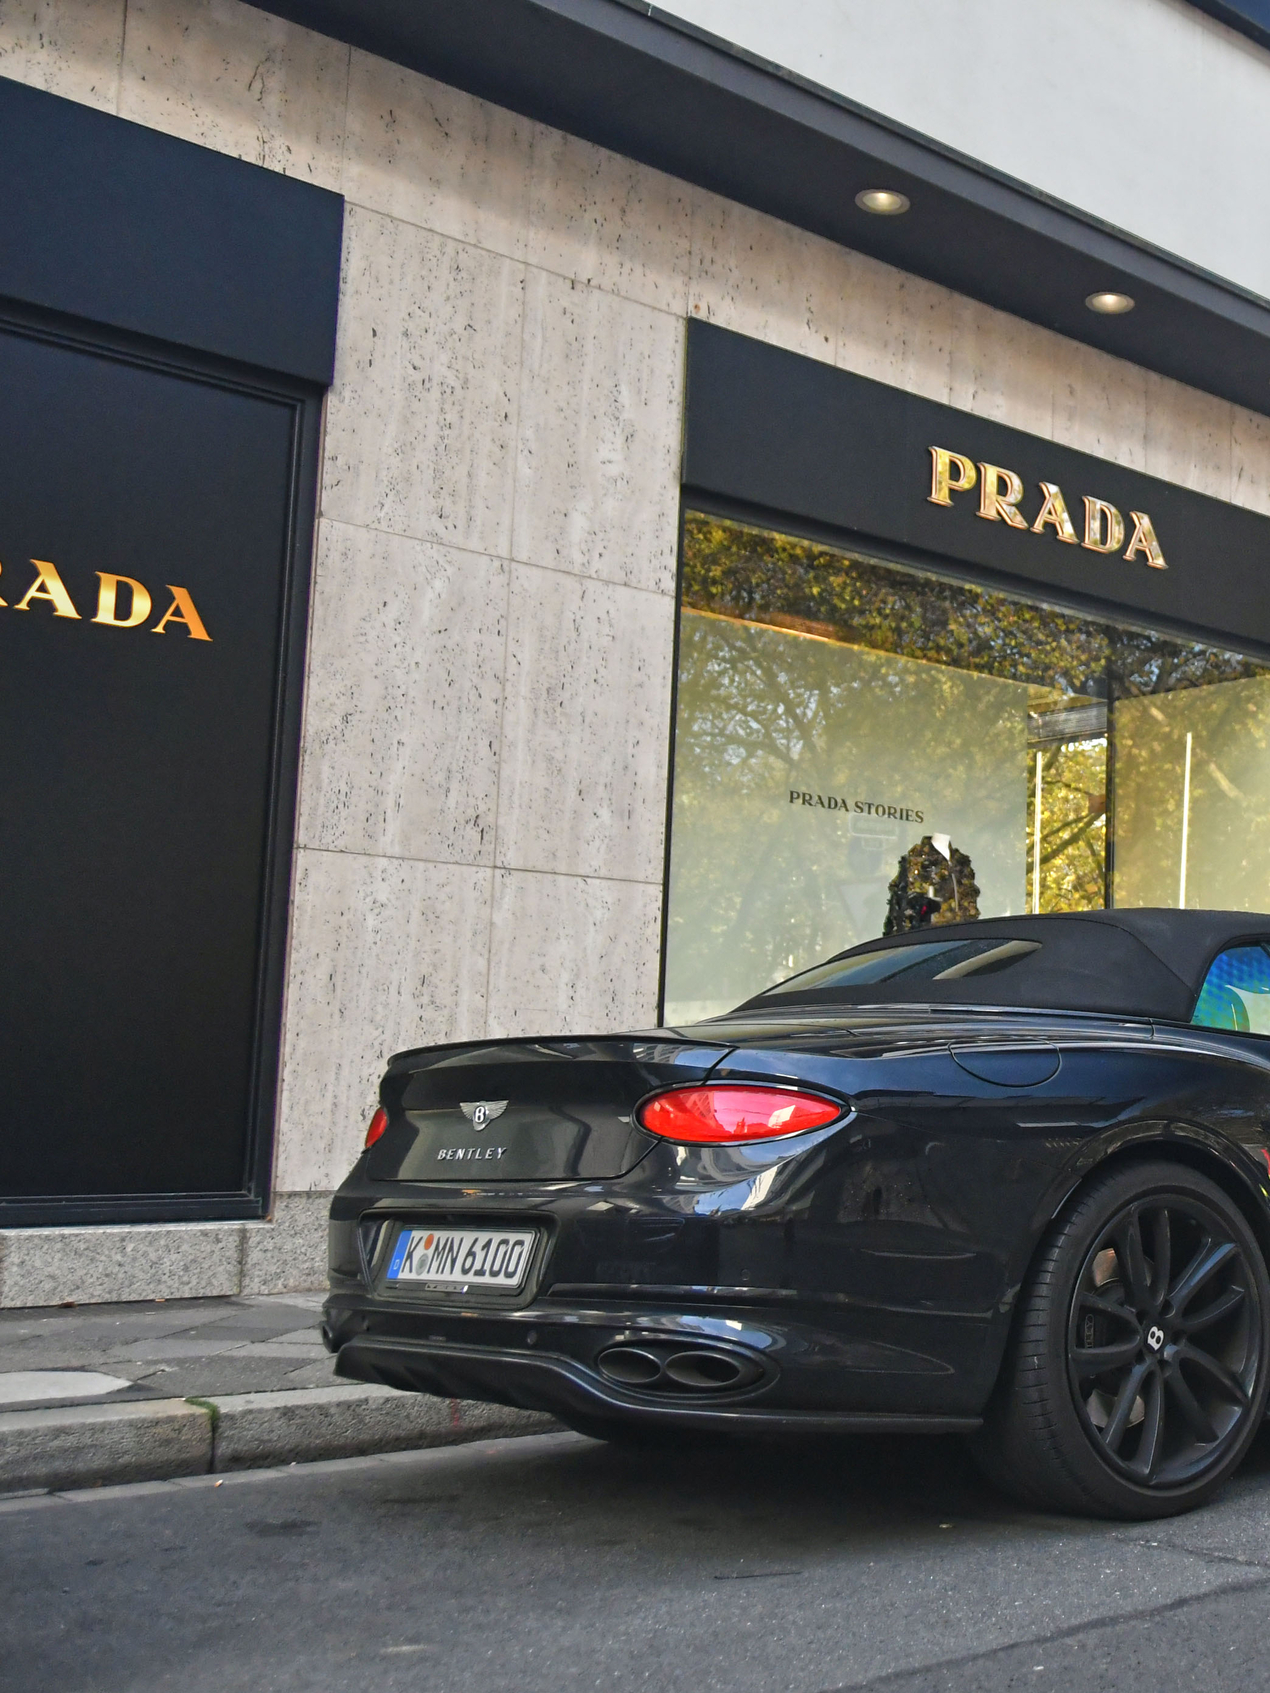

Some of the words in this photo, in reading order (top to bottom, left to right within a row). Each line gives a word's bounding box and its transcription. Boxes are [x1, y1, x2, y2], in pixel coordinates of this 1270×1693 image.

[927, 446, 1168, 569] PRADA
[0, 558, 213, 642] ADA
[789, 790, 849, 812] PRADA
[853, 801, 924, 823] STORIES
[437, 1147, 507, 1160] BENTLEY
[401, 1236, 423, 1273] K
[426, 1236, 463, 1275] MN
[461, 1237, 525, 1279] 6100
